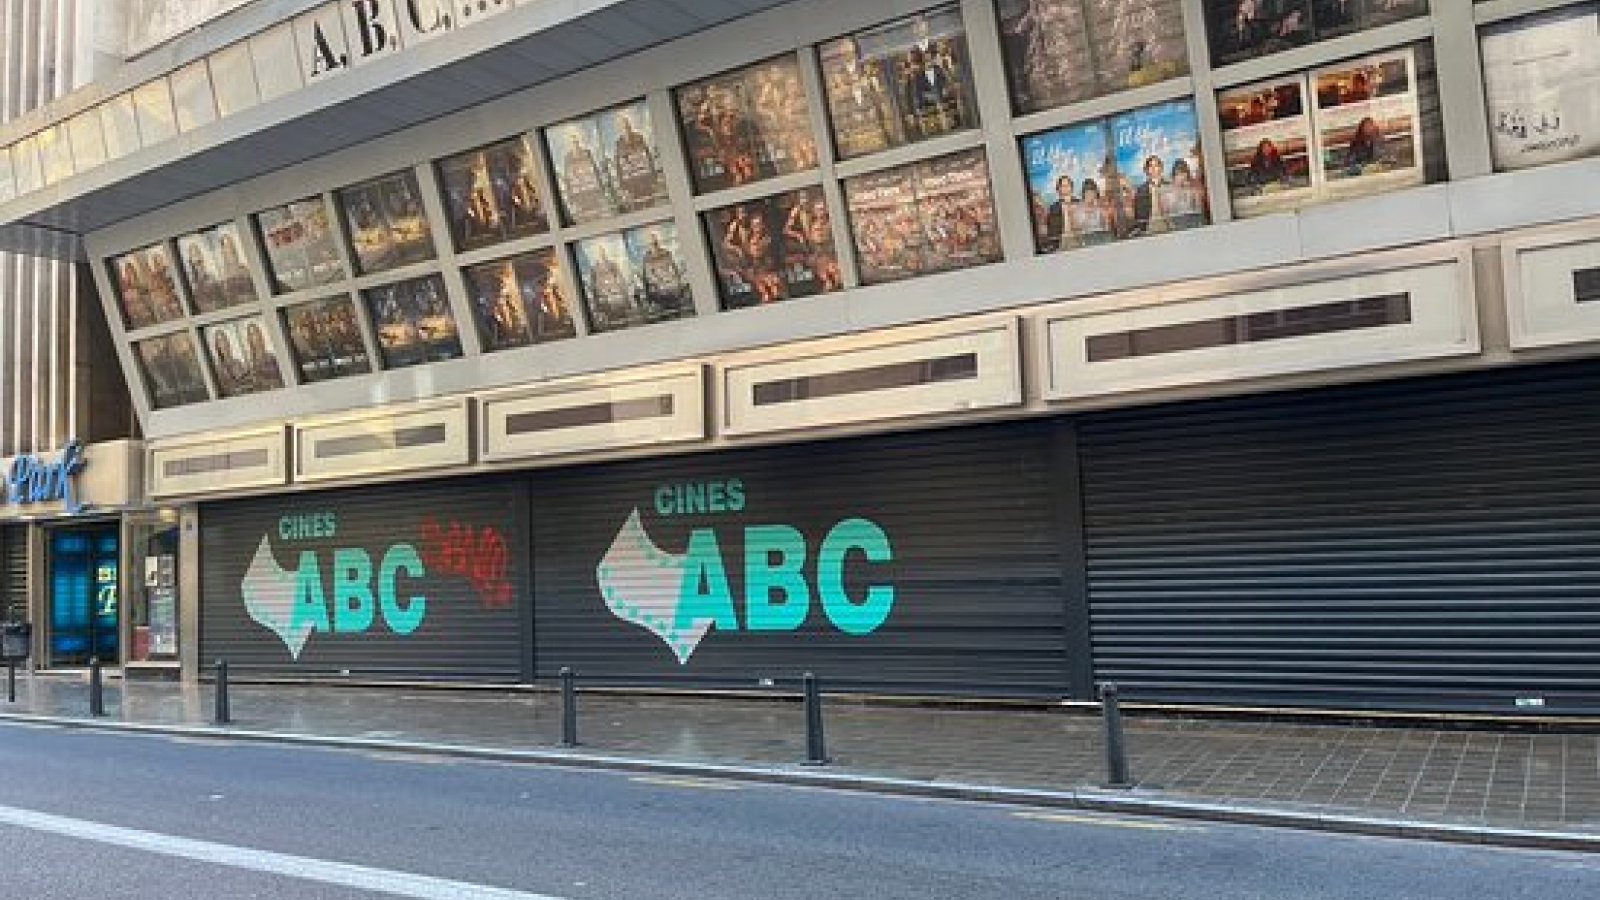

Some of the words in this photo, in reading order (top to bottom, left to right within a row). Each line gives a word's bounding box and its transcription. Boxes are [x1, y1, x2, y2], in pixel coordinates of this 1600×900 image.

[278, 511, 337, 540] CINES
[654, 479, 746, 514] CINES
[292, 543, 427, 635] ABC
[673, 517, 895, 635] ABC
